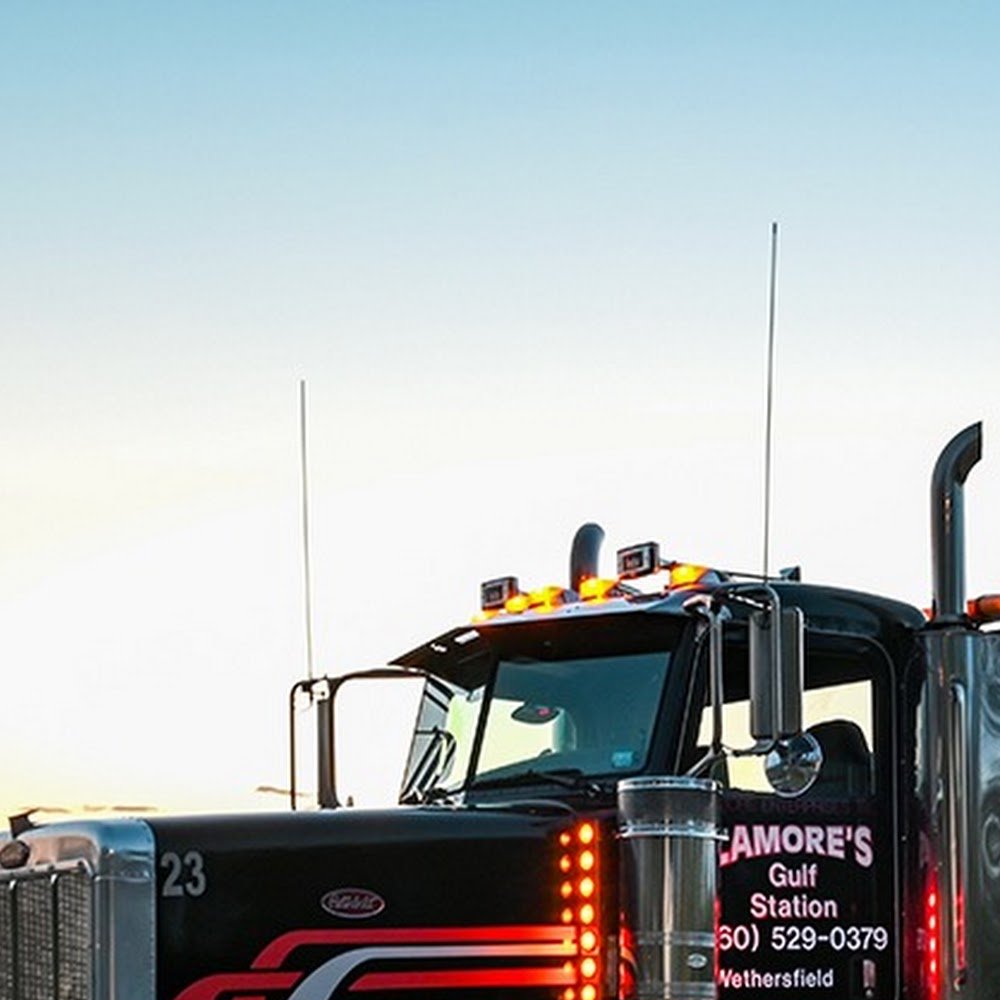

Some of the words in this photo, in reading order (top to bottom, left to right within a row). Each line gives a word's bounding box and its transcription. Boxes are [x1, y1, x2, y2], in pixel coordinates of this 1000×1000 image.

[160, 851, 207, 897] 23
[768, 862, 818, 887] Gulf
[750, 892, 838, 918] Station
[771, 926, 888, 950] 529-0379
